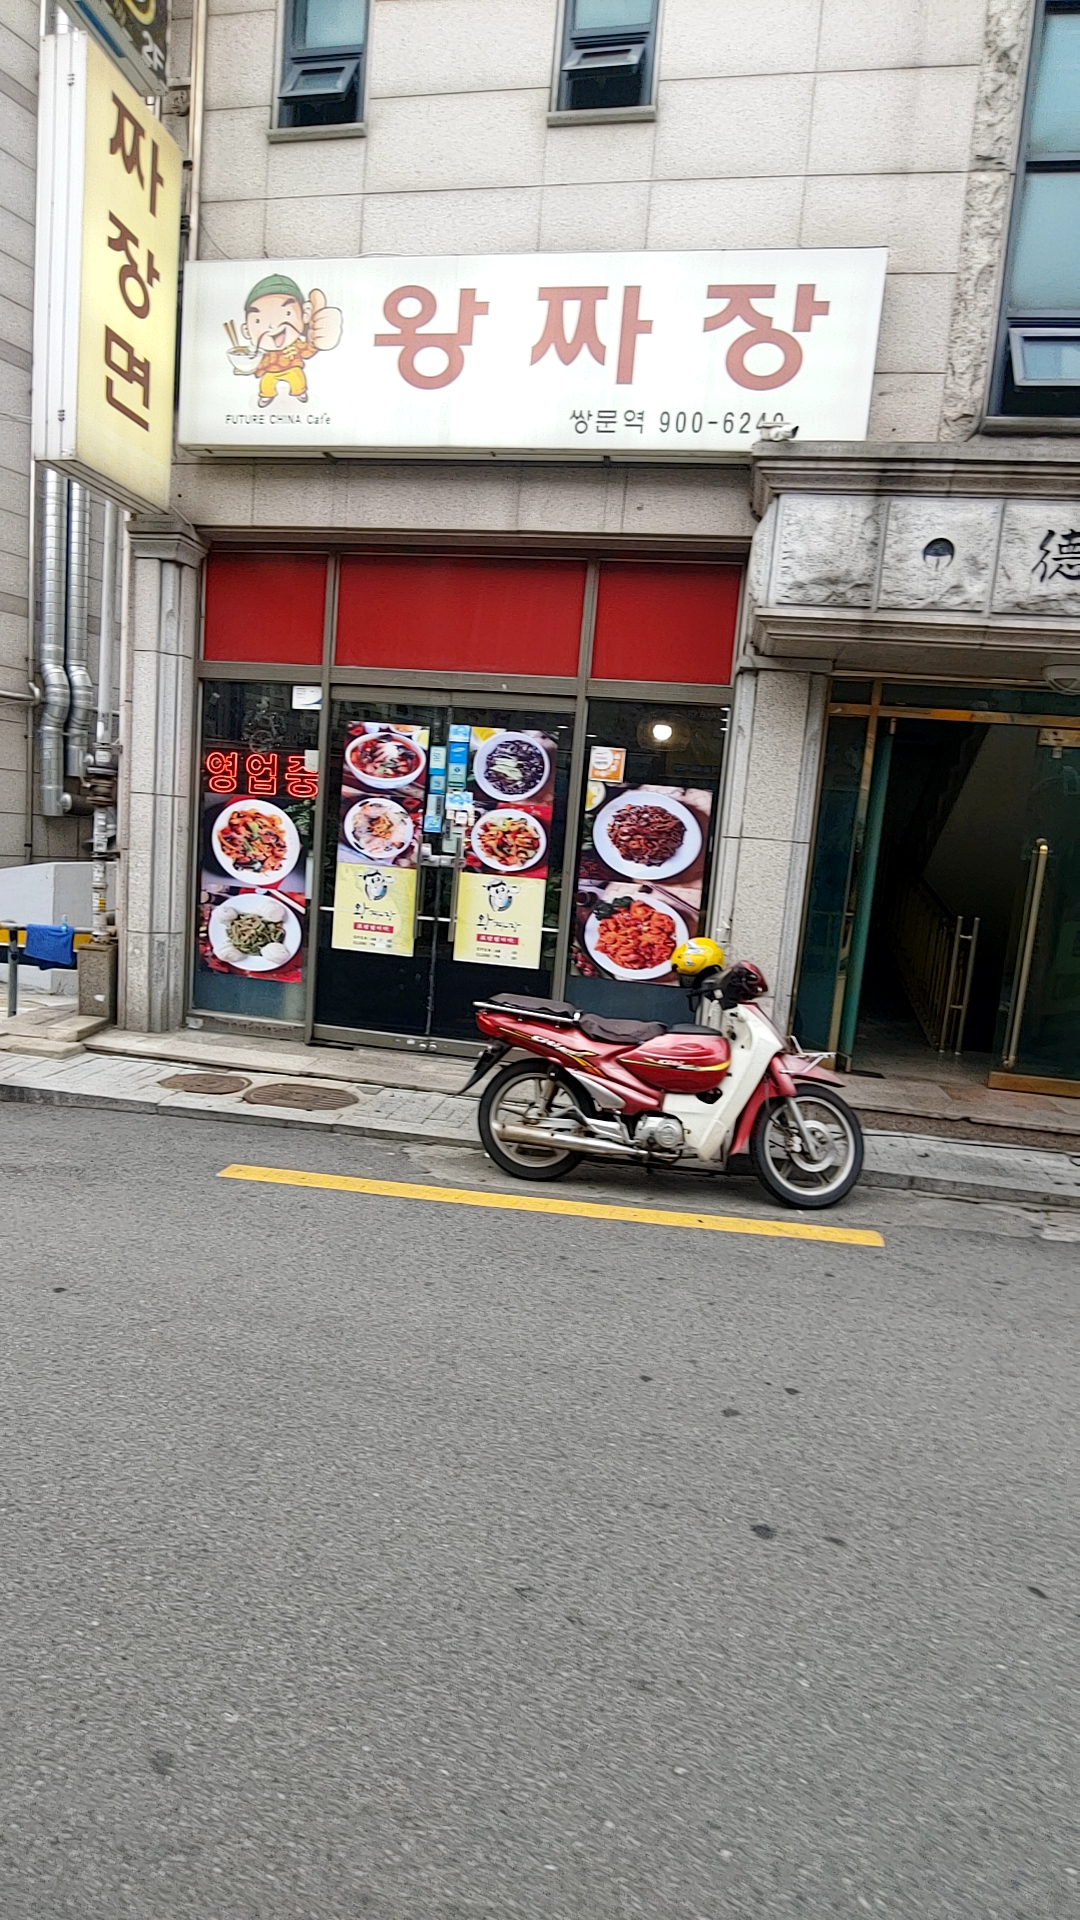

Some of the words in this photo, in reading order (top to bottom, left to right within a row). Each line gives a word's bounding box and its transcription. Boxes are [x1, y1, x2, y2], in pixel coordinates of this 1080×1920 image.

[104, 90, 164, 432] 짜장면
[225, 414, 266, 424] FUTURE
[269, 414, 302, 424] CHINA
[569, 410, 645, 434] 쌍문역
